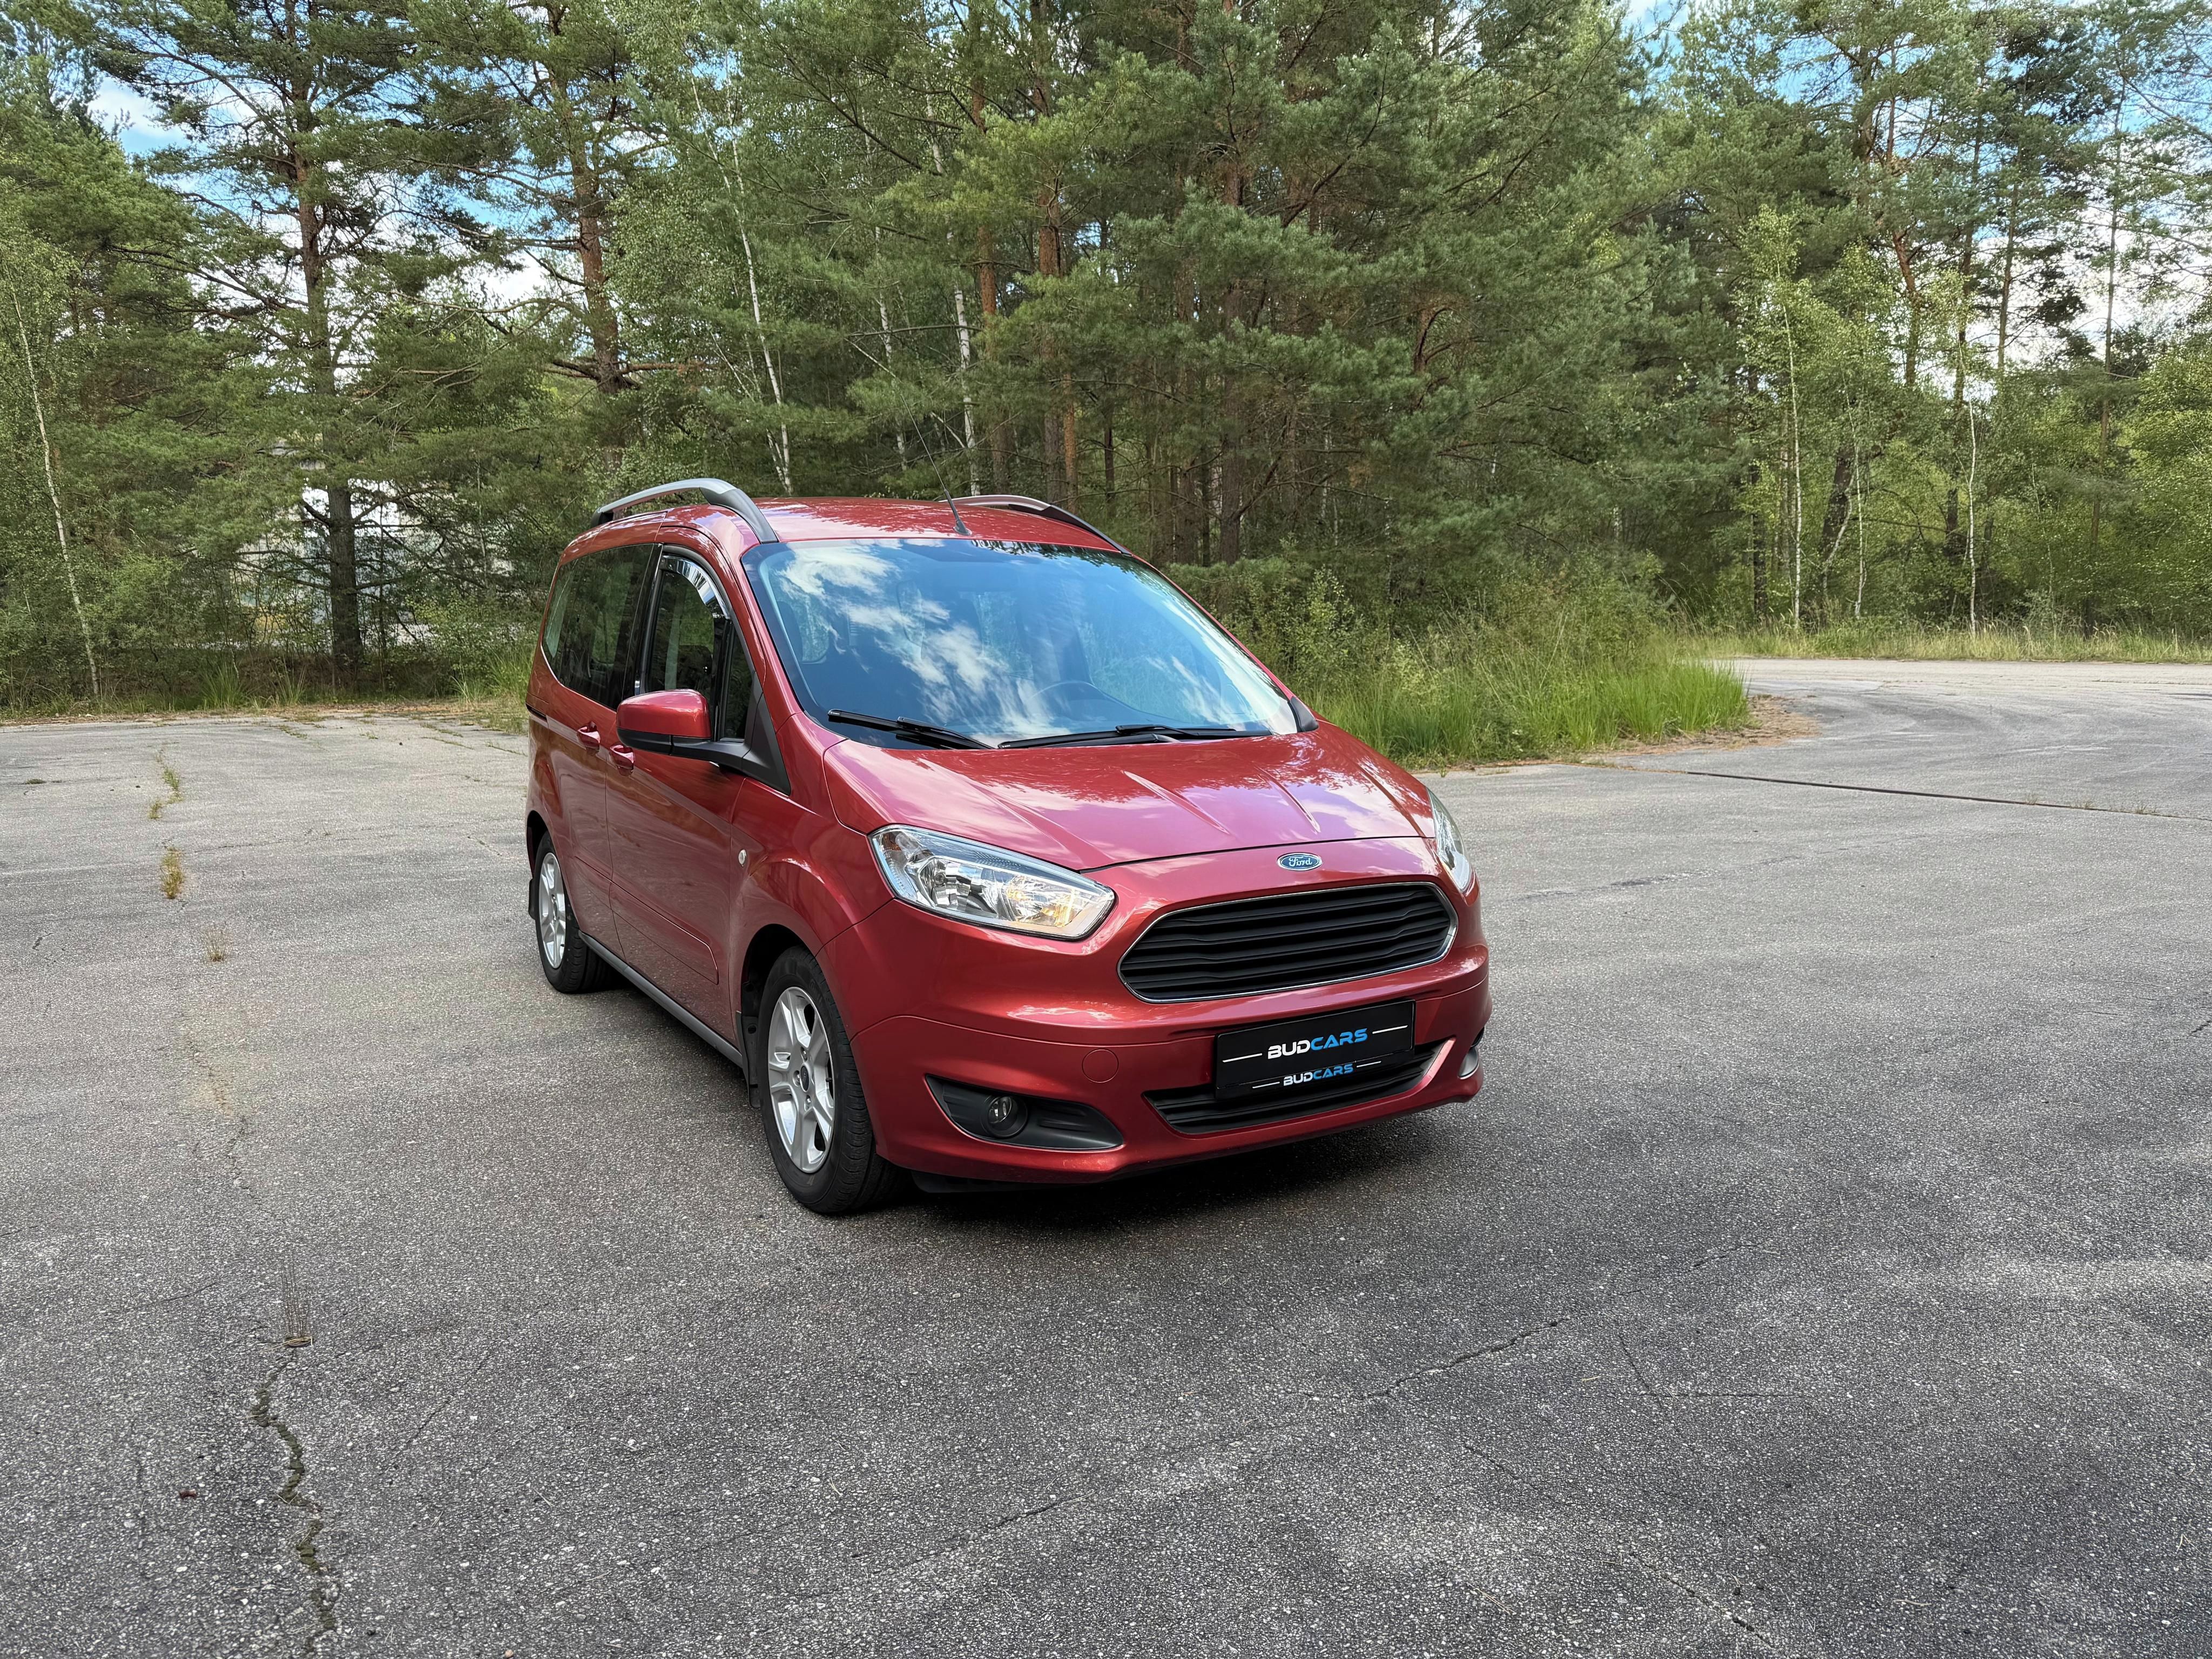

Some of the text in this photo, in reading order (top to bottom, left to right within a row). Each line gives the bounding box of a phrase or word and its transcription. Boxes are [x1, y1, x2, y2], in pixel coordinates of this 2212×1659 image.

[1289, 857, 1313, 867] Ford
[1267, 1028, 1368, 1060] BUDCARS
[1283, 1063, 1353, 1086] BUDCARS
